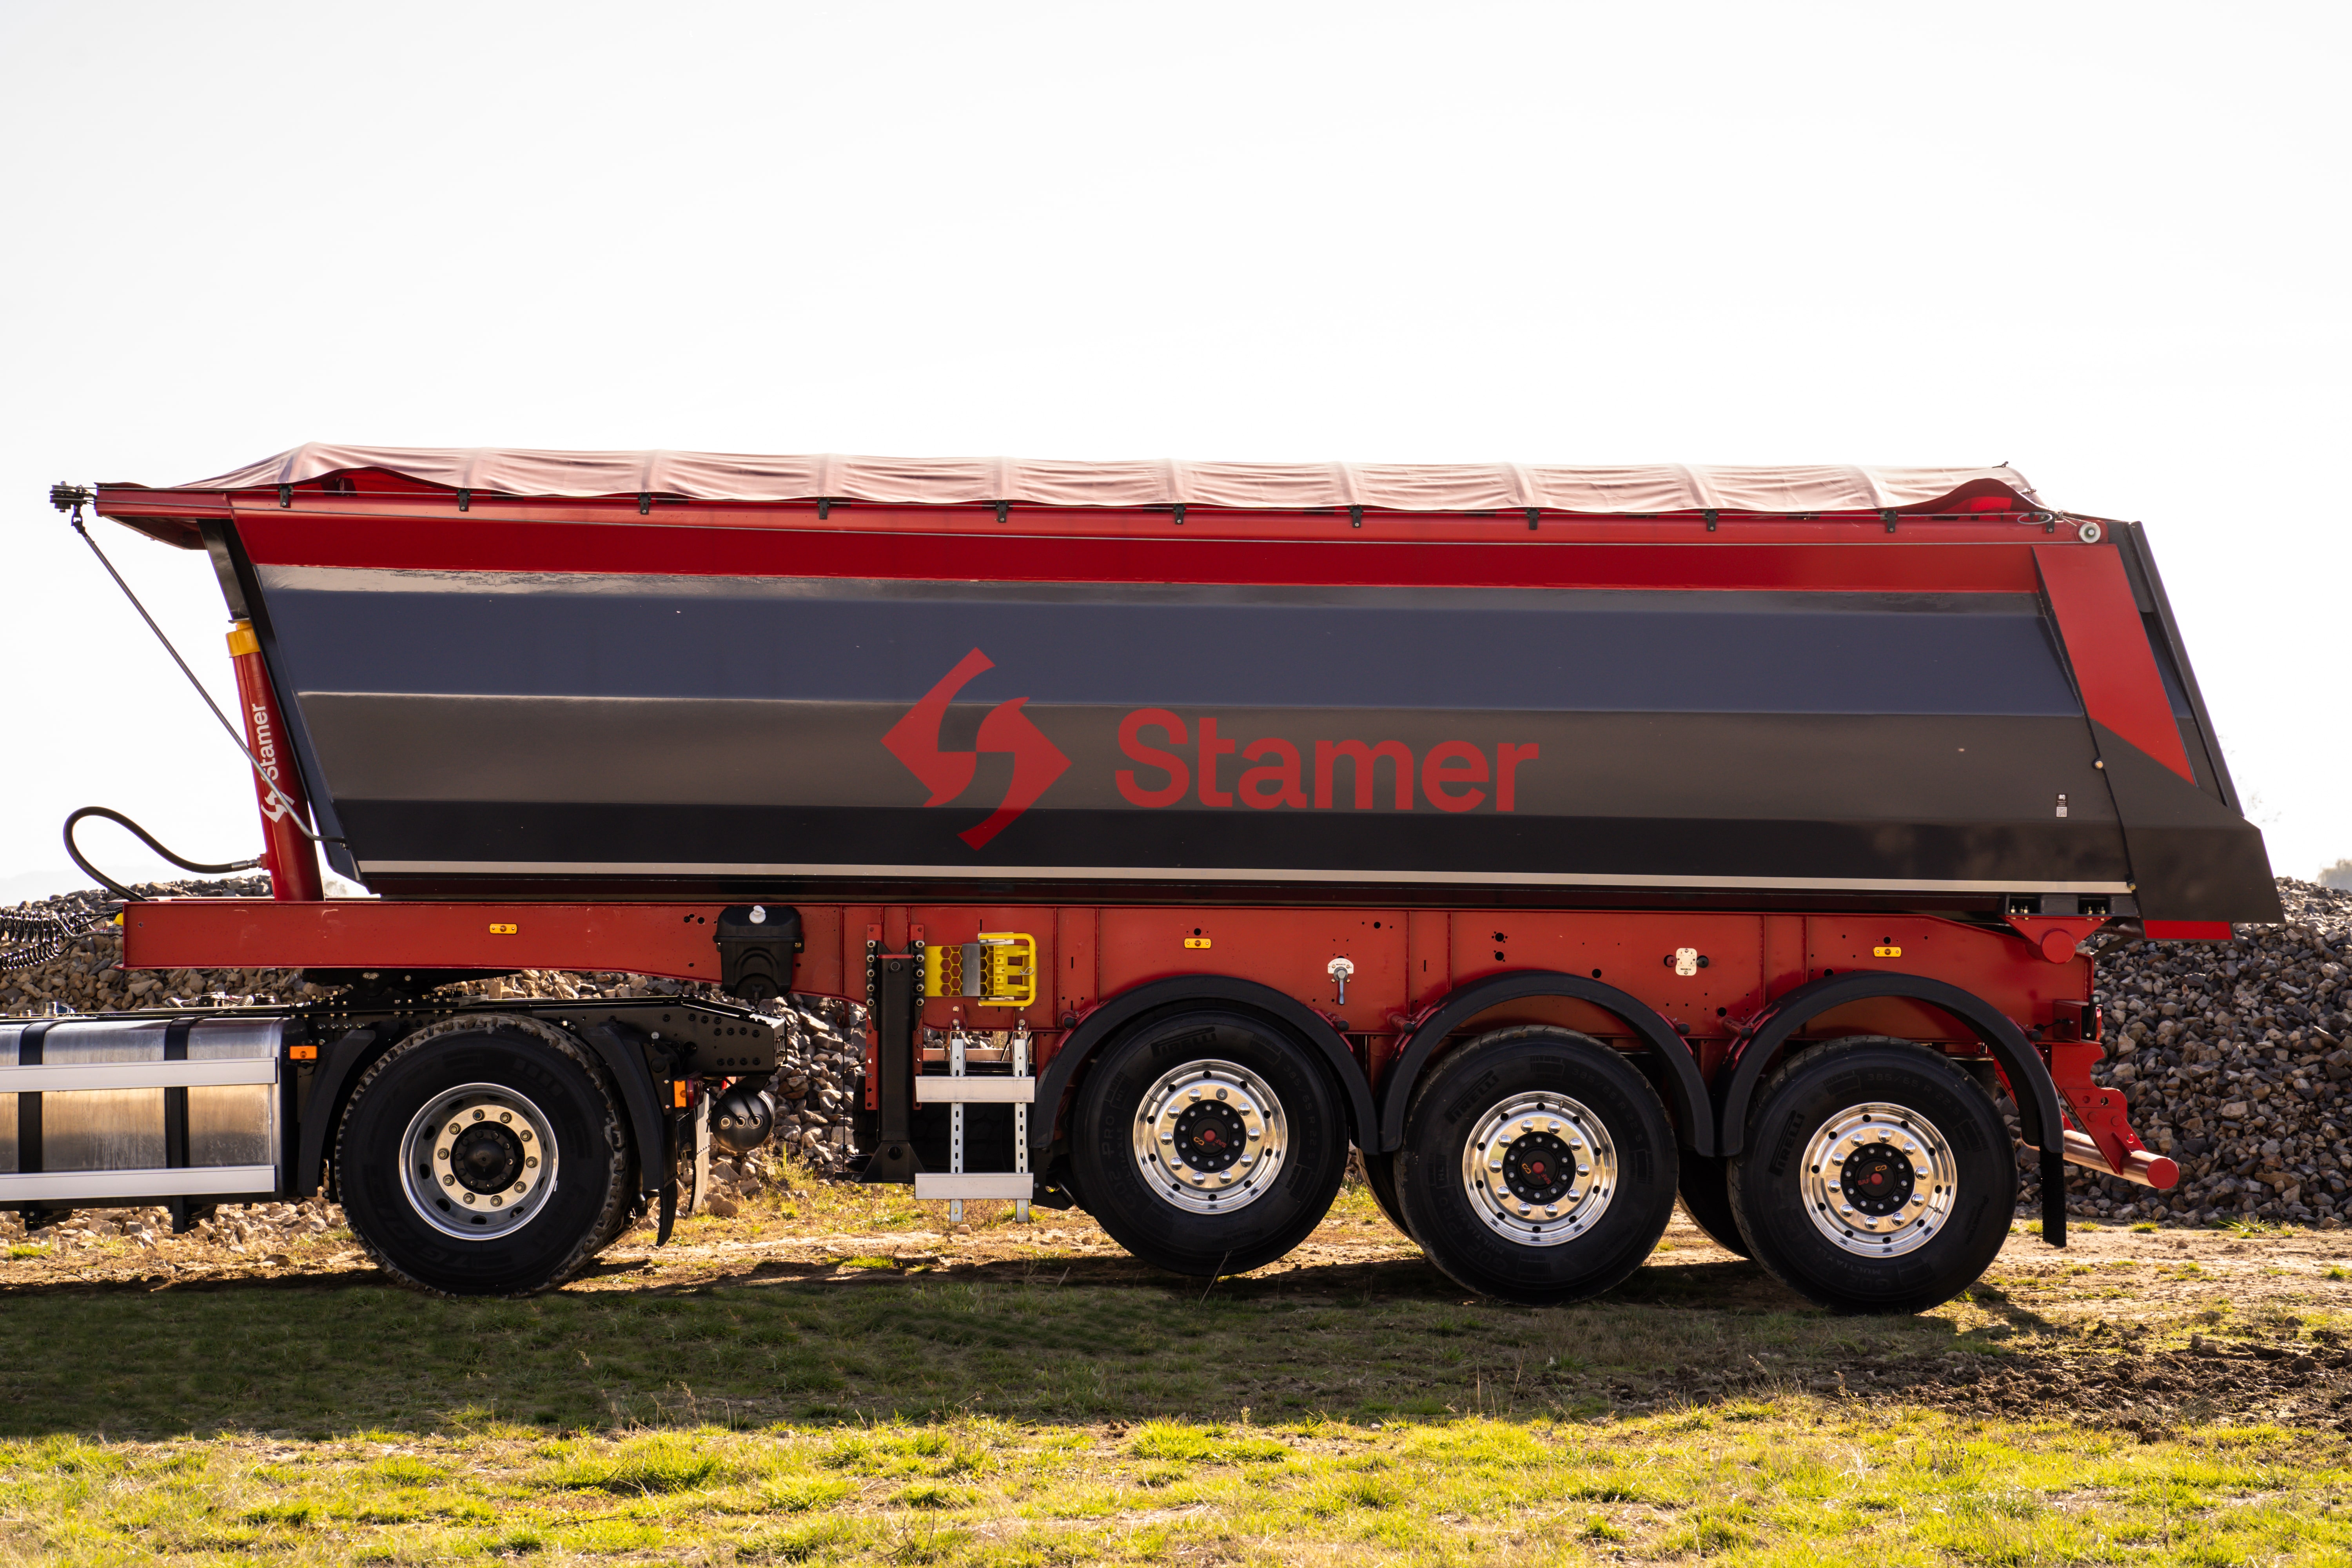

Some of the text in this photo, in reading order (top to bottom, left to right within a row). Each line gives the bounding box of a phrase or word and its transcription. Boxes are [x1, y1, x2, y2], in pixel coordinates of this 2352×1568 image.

[252, 703, 278, 781] Stamer
[1115, 708, 1539, 813] Stamer
[1150, 1027, 1217, 1058] PIRELLI
[1444, 1070, 1500, 1125] PIRELLI
[1867, 1073, 1919, 1088] 385/65
[1307, 1130, 1317, 1160] 225
[1625, 1113, 1643, 1142] 225
[1768, 1109, 1806, 1177] PIRELLI
